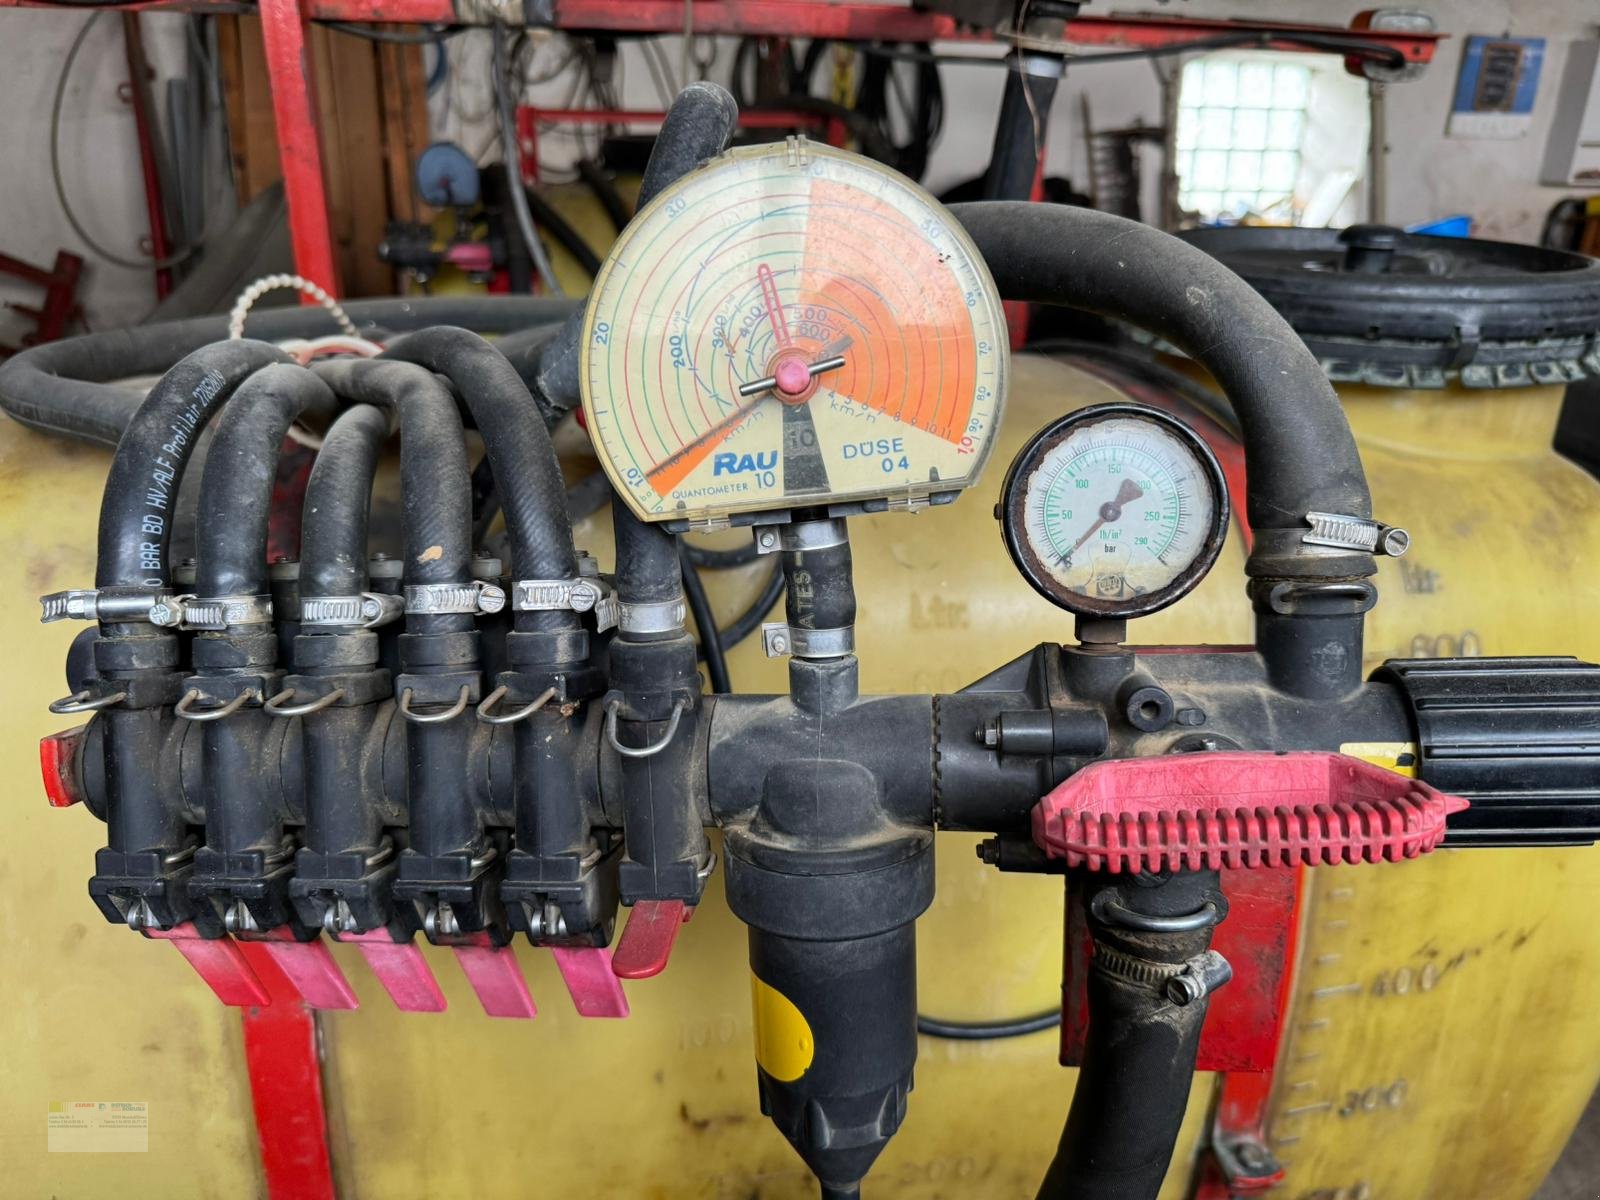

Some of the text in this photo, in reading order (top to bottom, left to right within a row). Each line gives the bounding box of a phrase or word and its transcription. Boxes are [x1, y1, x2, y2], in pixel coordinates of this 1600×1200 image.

[669, 335, 686, 369] 200
[161, 402, 201, 461] Profilair
[843, 437, 905, 460] DÜSE
[712, 450, 778, 477] RAU
[1107, 463, 1122, 475] 150
[672, 470, 776, 501] QUANTOMETER 10
[1075, 479, 1090, 489] 100
[140, 513, 165, 536] BD
[1062, 510, 1073, 520] 50
[1143, 511, 1161, 522] 250
[1104, 543, 1117, 553] bar
[1133, 536, 1149, 546] 290
[139, 542, 162, 571] BAR
